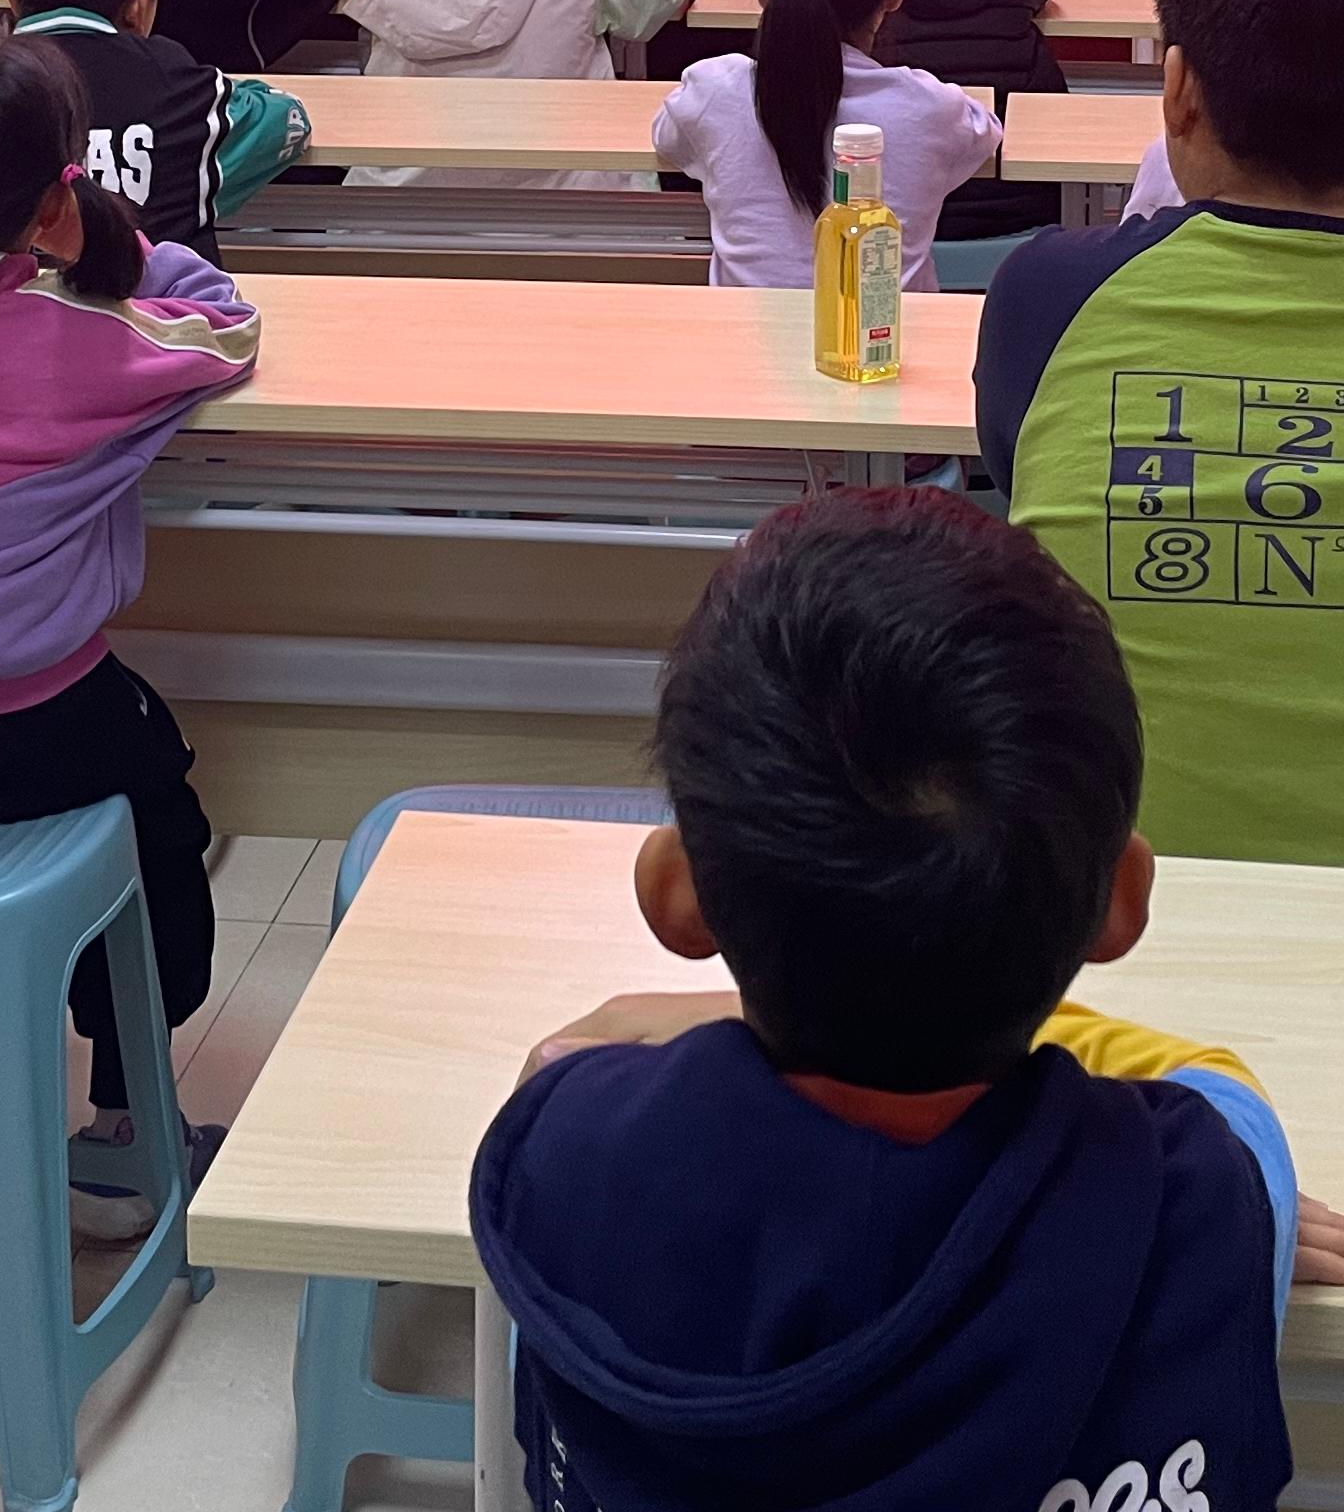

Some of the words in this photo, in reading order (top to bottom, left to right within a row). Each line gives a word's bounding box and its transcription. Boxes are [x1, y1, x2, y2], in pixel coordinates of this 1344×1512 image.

[86, 122, 154, 207] AS
[1155, 386, 1194, 444] 1
[1257, 384, 1268, 403] 1
[1294, 387, 1310, 405] 2
[1276, 414, 1334, 459] 2
[1137, 454, 1163, 482] 4
[1244, 462, 1322, 521] 6
[1137, 486, 1164, 517] 5
[1133, 527, 1211, 593] 8
